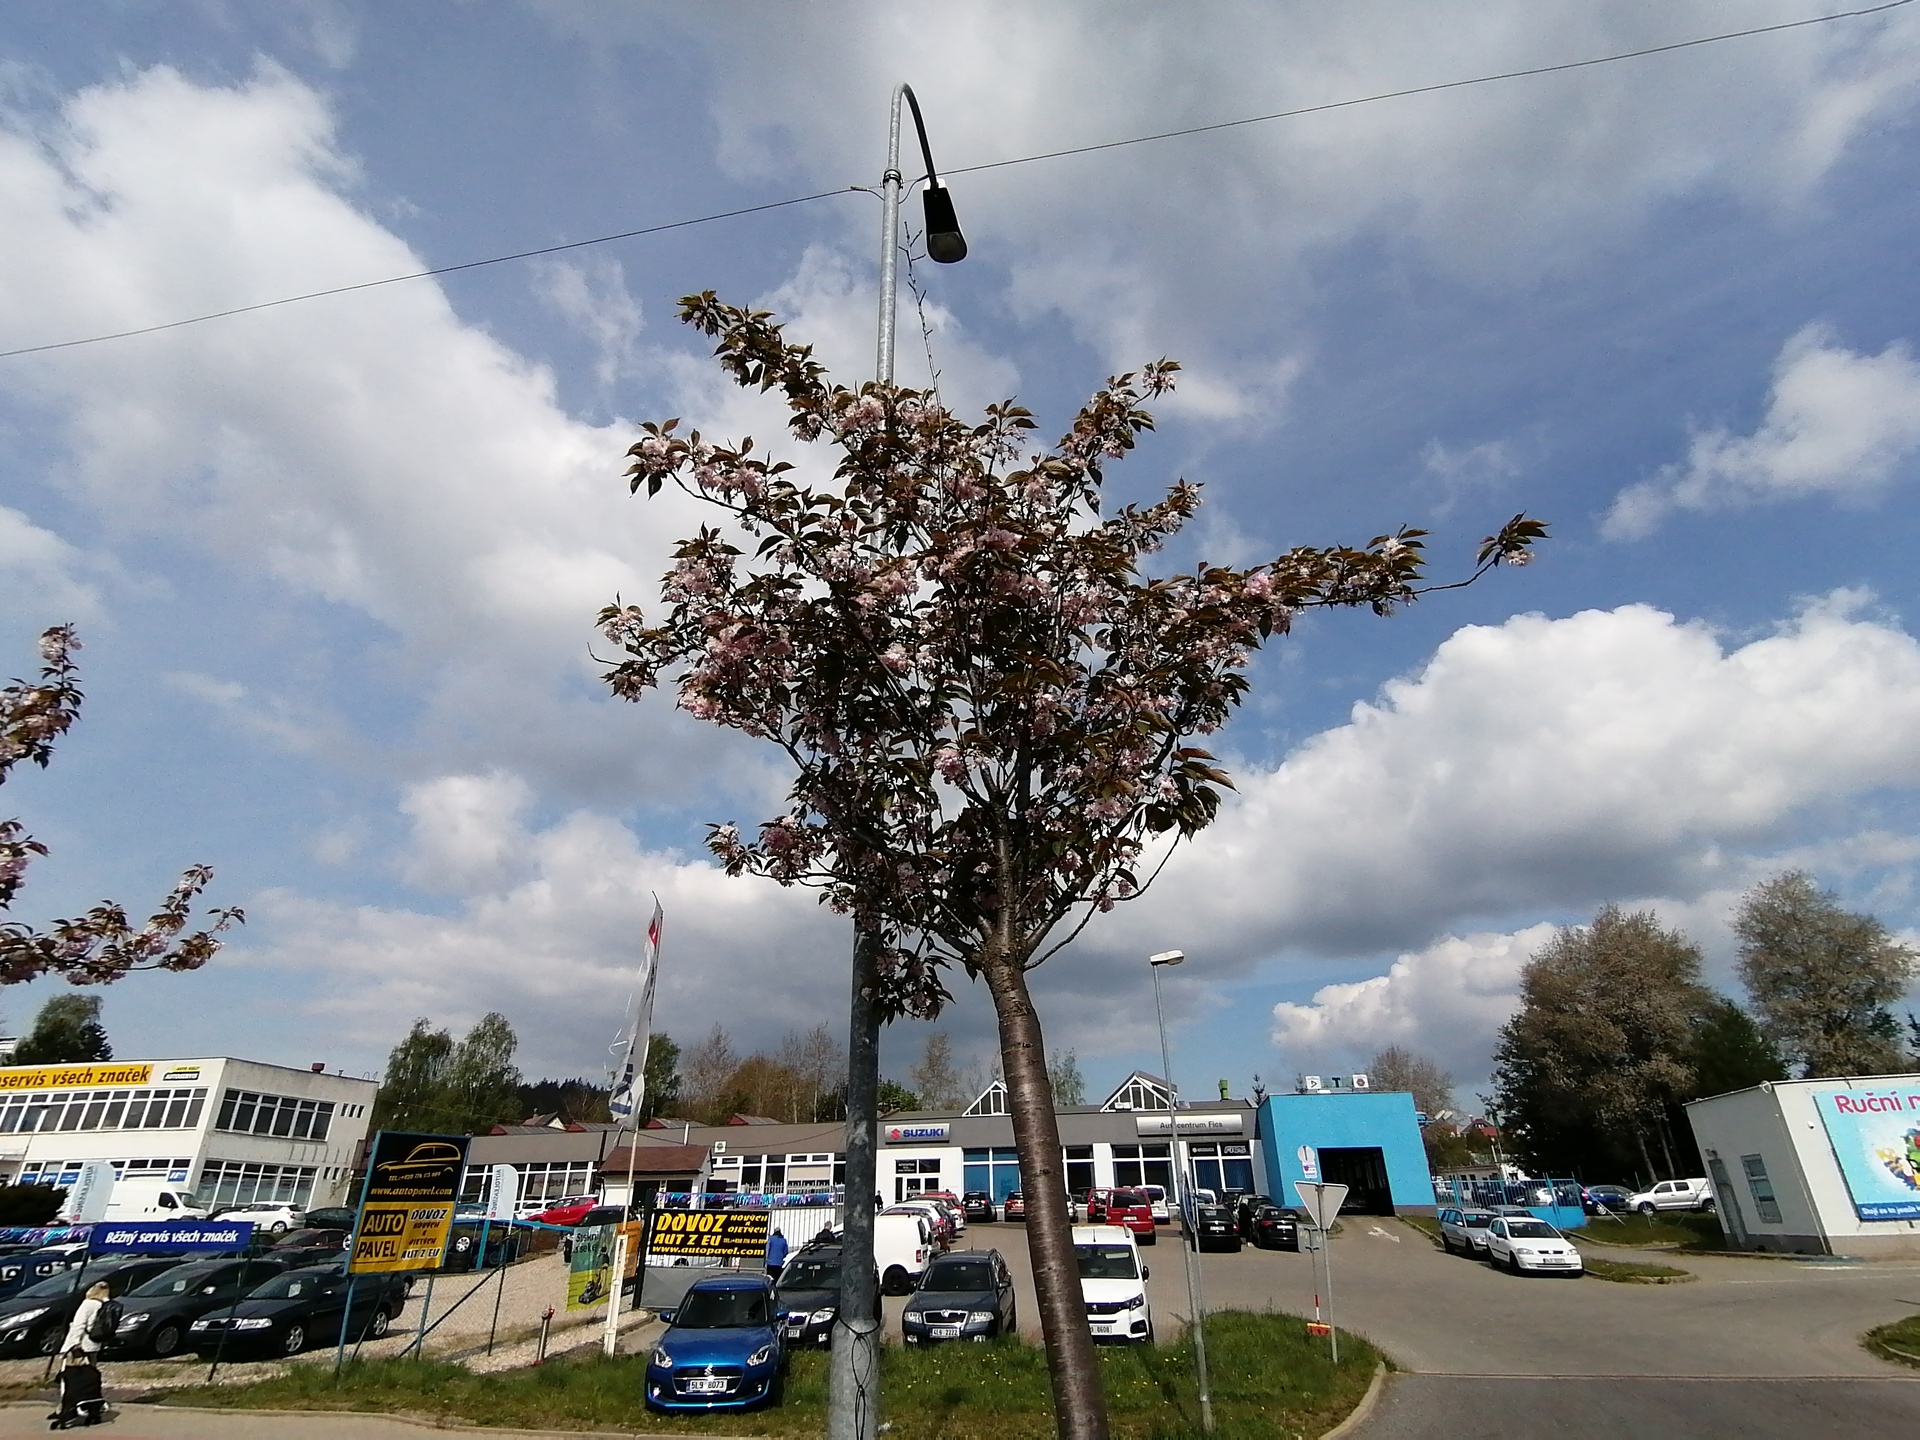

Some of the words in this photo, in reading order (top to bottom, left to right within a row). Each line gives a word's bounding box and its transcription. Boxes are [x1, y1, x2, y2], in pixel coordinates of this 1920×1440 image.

[52, 1067, 93, 1085] všech
[97, 1065, 150, 1083] značek
[1834, 1091, 1902, 1114] Ruční
[903, 1128, 944, 1138] SUZUKI
[370, 1186, 452, 1198] www.autopavel.com
[410, 1208, 448, 1220] DOVOZ
[363, 1213, 405, 1233] AUTO
[656, 1213, 728, 1232] DOVOZ
[104, 1230, 138, 1246] Běžný
[137, 1230, 170, 1244] servis
[171, 1230, 200, 1243] všech
[200, 1230, 239, 1243] značek
[653, 1233, 685, 1245] AUT
[687, 1234, 699, 1246] Z
[701, 1235, 722, 1246] EU
[356, 1240, 397, 1259] PAVEL
[401, 1249, 419, 1259] AUT
[420, 1249, 427, 1258] Z
[428, 1248, 441, 1257] EU
[652, 1246, 765, 1256] www.autopavel.com
[691, 1381, 704, 1389] 5L9
